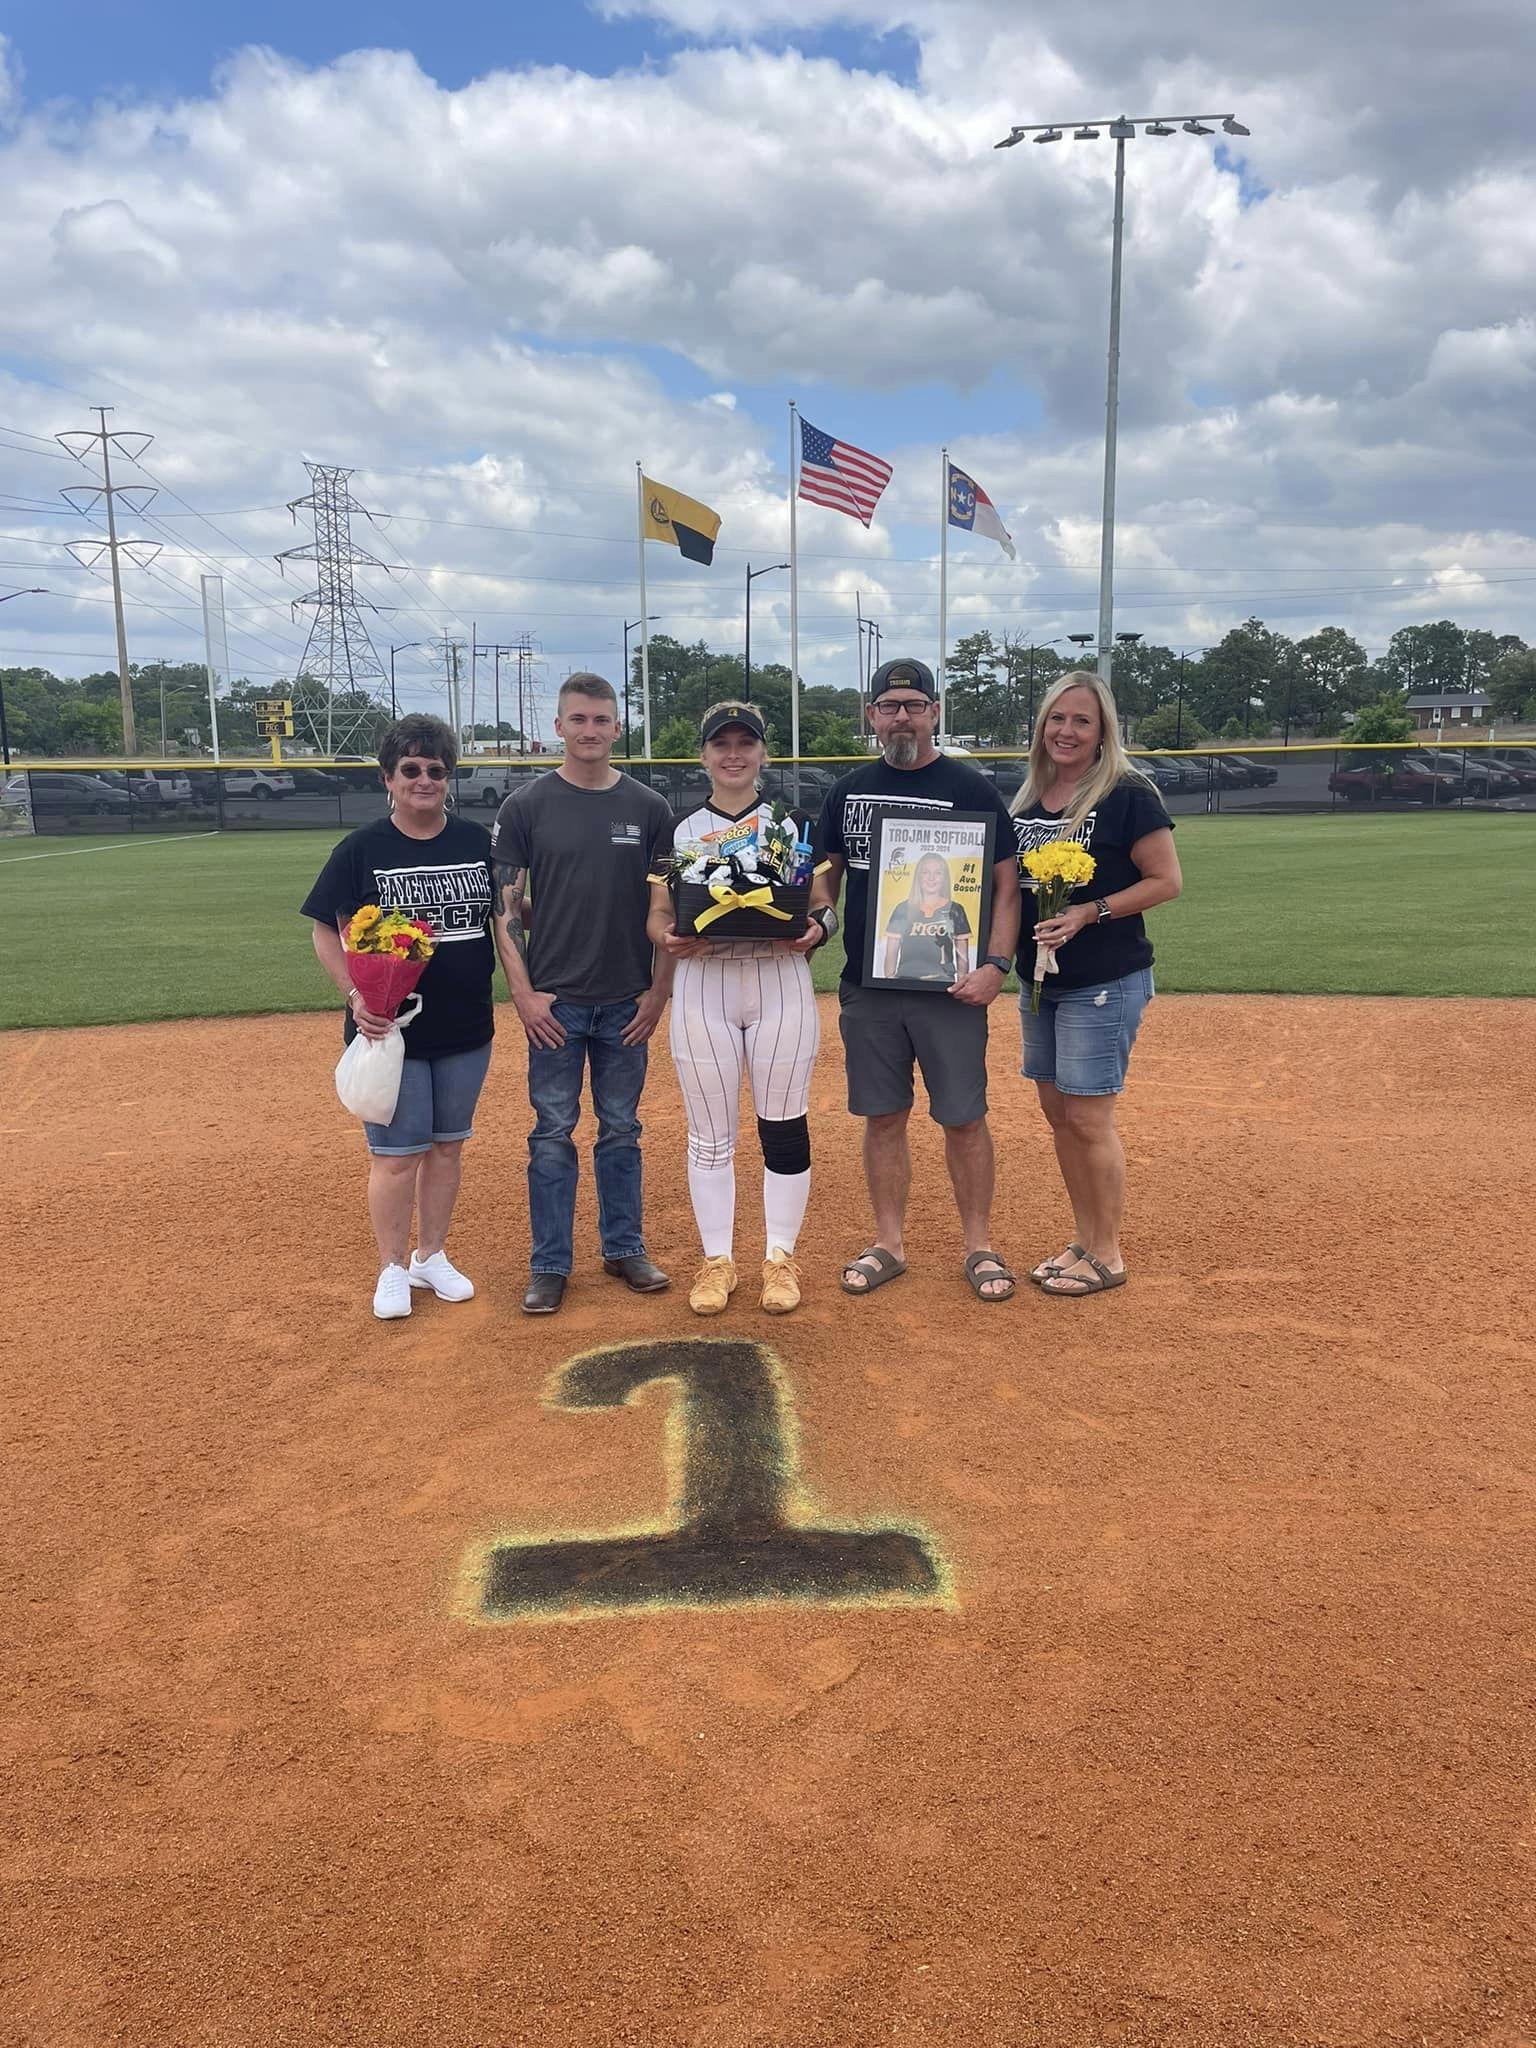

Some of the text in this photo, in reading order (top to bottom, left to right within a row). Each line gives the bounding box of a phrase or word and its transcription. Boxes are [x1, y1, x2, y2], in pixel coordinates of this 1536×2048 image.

[967, 492, 975, 507] C
[889, 828, 985, 847] TROJAN SOFTBALL
[962, 863, 975, 874] #1
[376, 867, 492, 908] FAYETTEVILLE
[959, 875, 976, 884] Ava
[462, 1337, 958, 1622] 1
